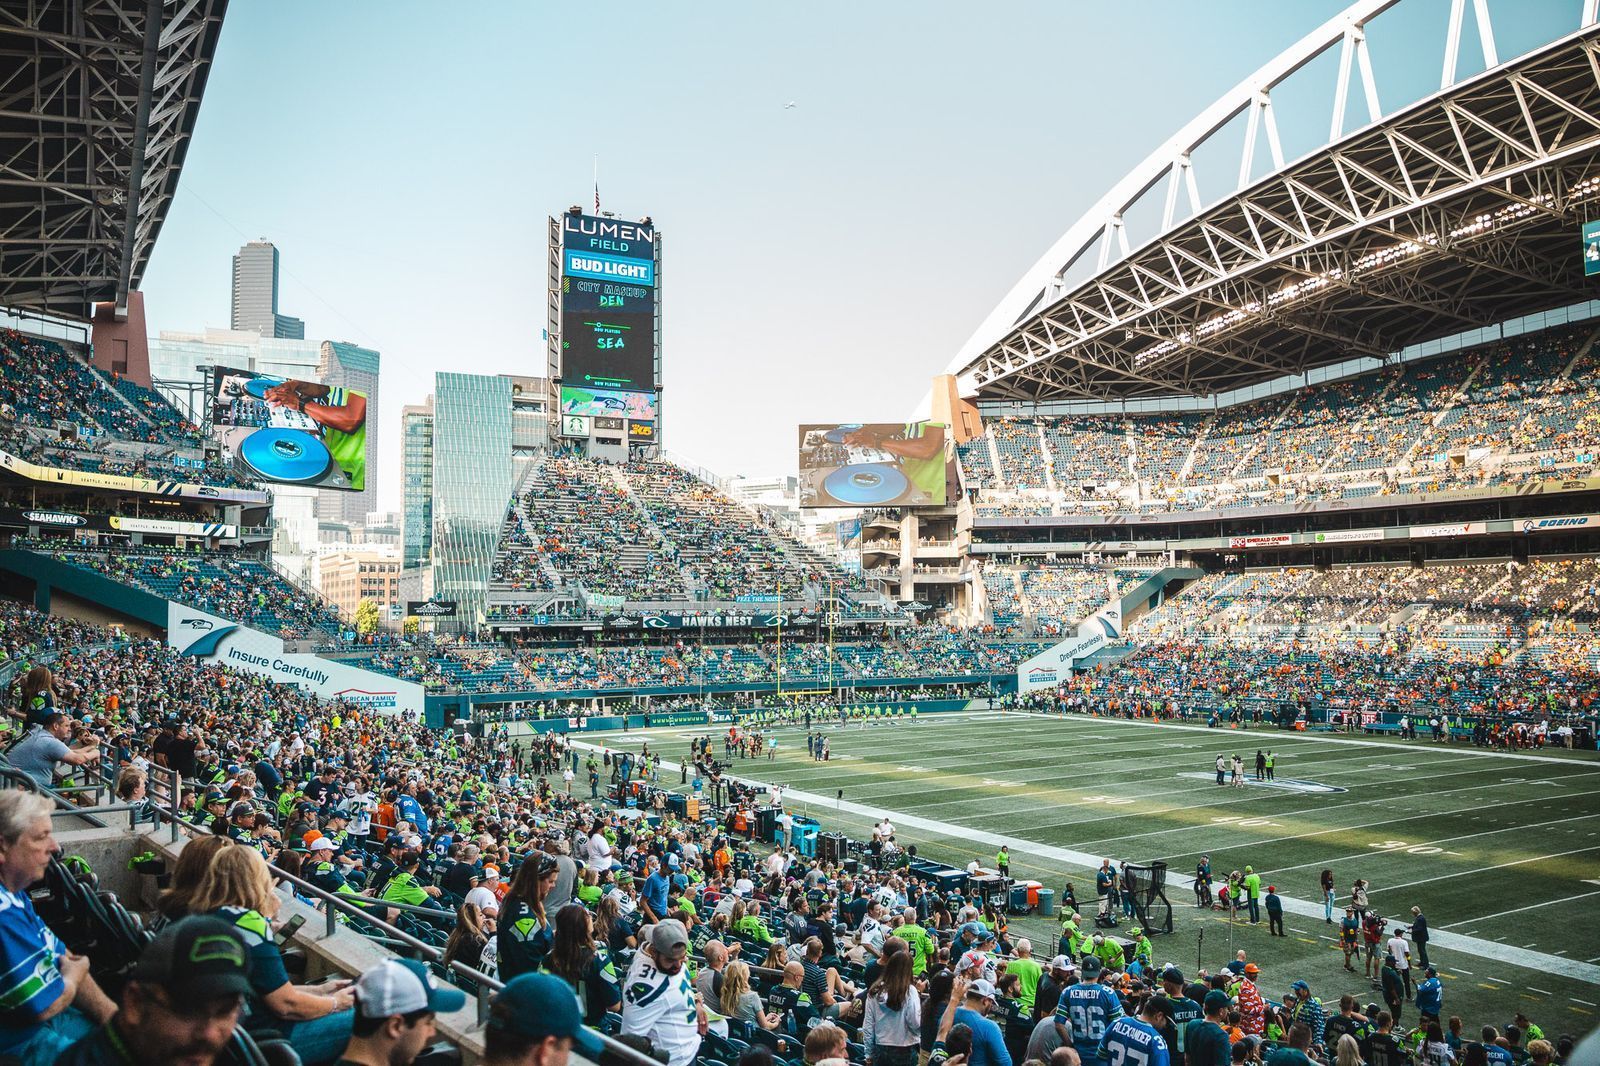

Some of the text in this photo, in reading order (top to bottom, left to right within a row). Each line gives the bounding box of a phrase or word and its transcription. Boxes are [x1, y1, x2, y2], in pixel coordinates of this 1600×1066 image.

[566, 217, 652, 242] LUMEN
[590, 238, 628, 252] FIELD
[572, 258, 646, 278] BUD LIGHT
[577, 281, 646, 298] CITY MASHUP
[600, 296, 624, 306] DEN
[597, 338, 624, 348] SEA
[178, 457, 186, 466] 12
[29, 513, 79, 524] SEAHAWKS
[1538, 517, 1588, 526] BOEING
[682, 616, 753, 626] HAWKS NEST
[346, 632, 354, 640] 12
[1060, 634, 1103, 662] Dream Fearlessly
[228, 647, 329, 685] Insure Carefully
[318, 790, 327, 806] 3
[737, 860, 742, 870] 3
[881, 896, 891, 907] 15
[519, 902, 528, 914] 3
[949, 902, 959, 913] 33
[639, 964, 657, 980] 31
[769, 995, 786, 1005] METCALF
[1070, 990, 1100, 999] KENNEDY
[1175, 1010, 1197, 1020] METCALF
[1070, 1005, 1105, 1040] 96
[1112, 1022, 1152, 1046] ALEXANDER
[1108, 1040, 1149, 1066] 37
